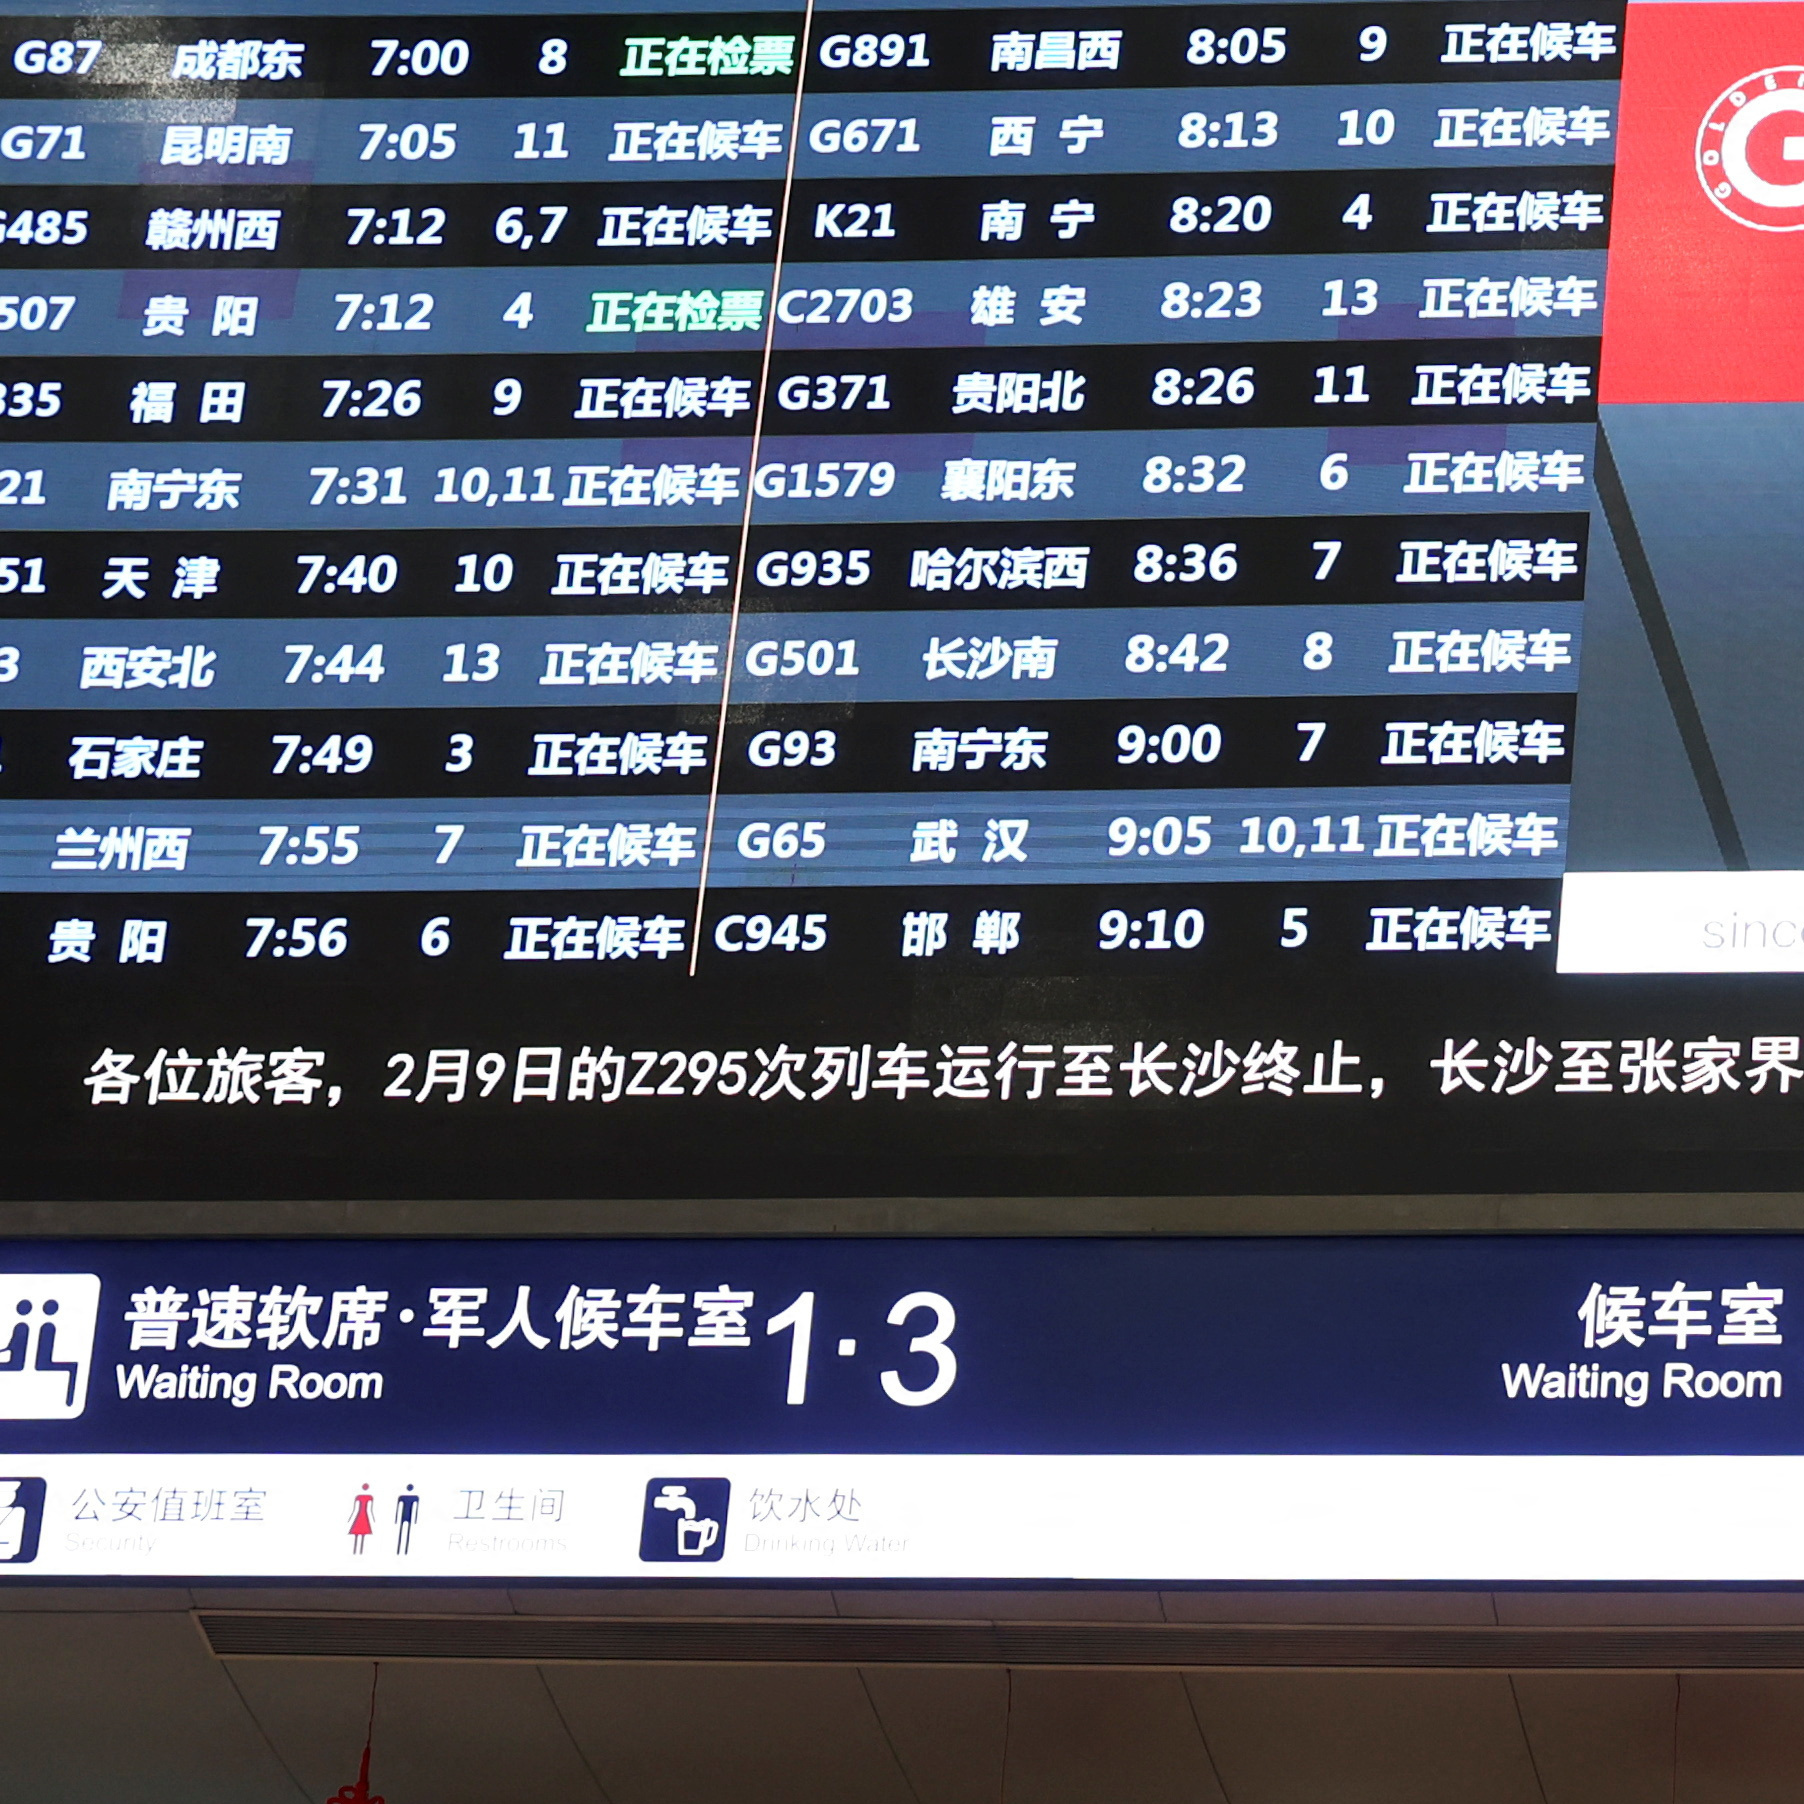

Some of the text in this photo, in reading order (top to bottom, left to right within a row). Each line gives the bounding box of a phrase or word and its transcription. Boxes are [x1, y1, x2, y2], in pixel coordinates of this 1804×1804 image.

[14, 35, 796, 87] G87 成都东 7:00 8 正在检票
[819, 20, 1617, 72] G891 南昌西 8:05 9 正在候车
[0, 204, 773, 251] 485 赣州西 7:12 6,7 正在候车
[778, 362, 1591, 414] G371 贵阳北 8:26 11 正在候车
[748, 719, 1565, 772] G93 南宁东 9:00 7 正在候车
[50, 821, 697, 871] 兰州西 7:55 7 正在候车
[125, 1284, 753, 1350] 普速软席·军人候车室
[1578, 1282, 1782, 1349] 候车室
[117, 1364, 382, 1407] Waiting Room
[1502, 1363, 1781, 1406] Waiting Room
[72, 1487, 267, 1523] 公安值班室
[453, 1488, 565, 1523] 卫生间
[749, 1488, 862, 1523] 饮水处
